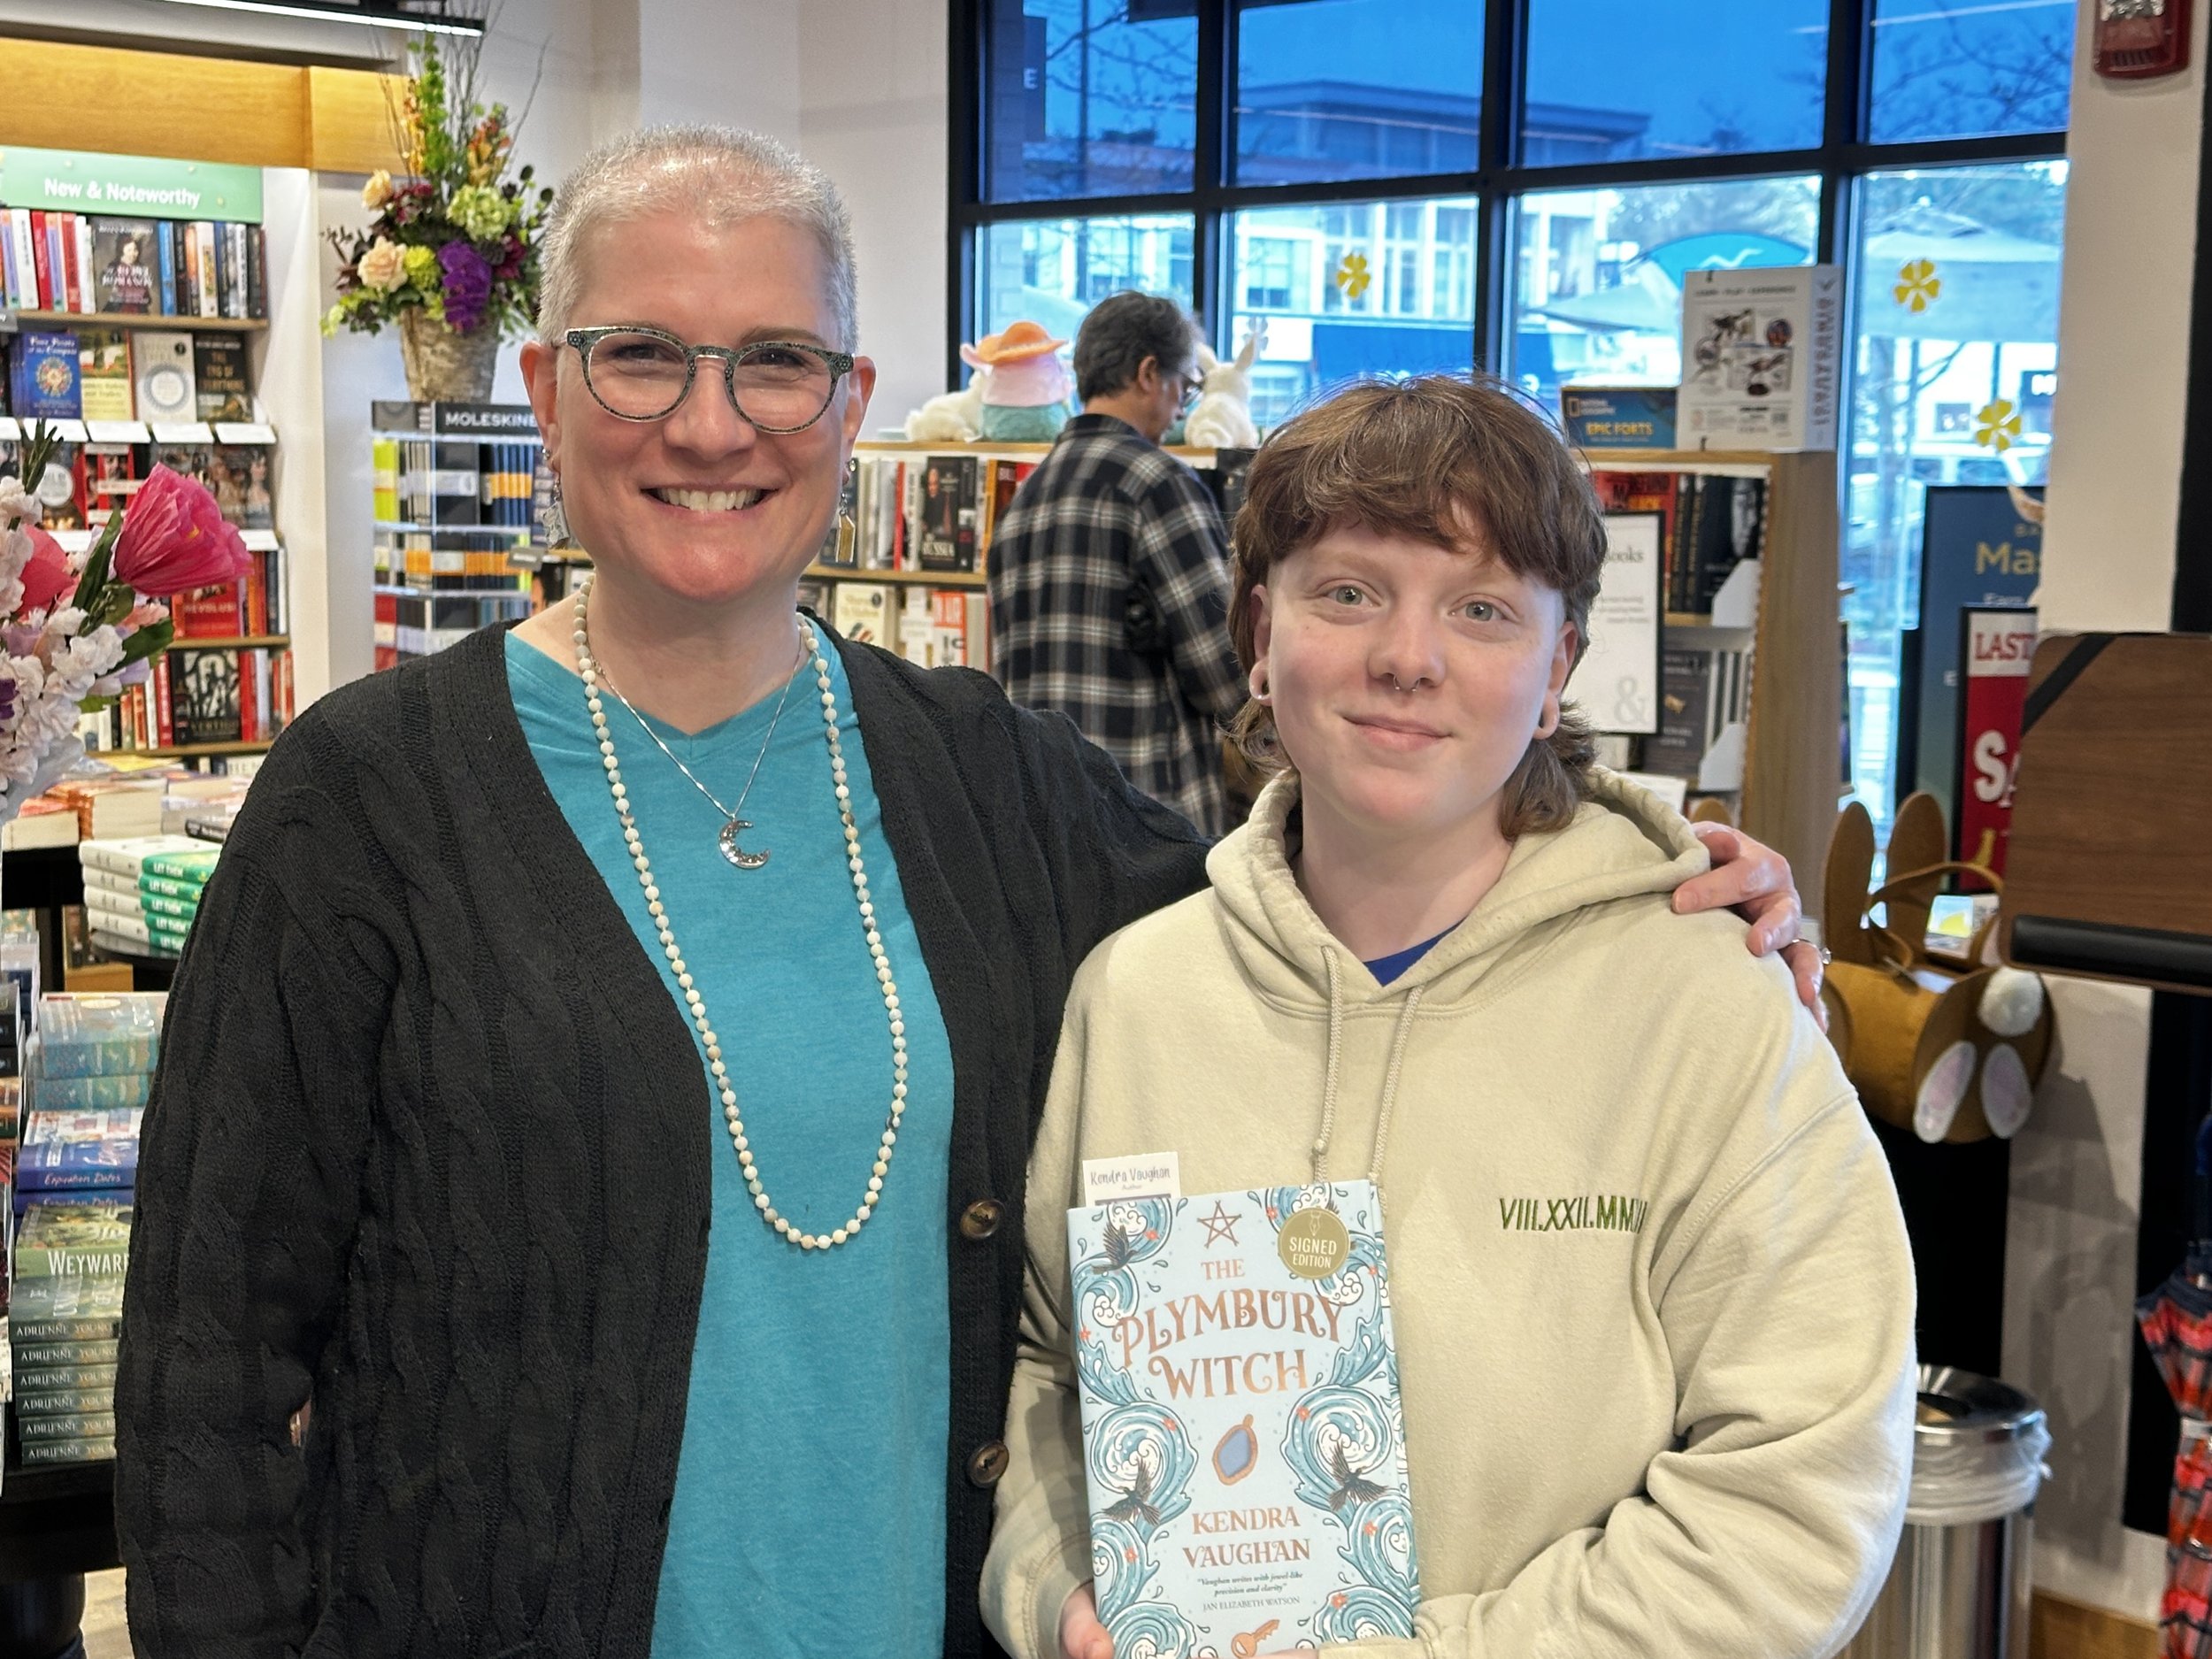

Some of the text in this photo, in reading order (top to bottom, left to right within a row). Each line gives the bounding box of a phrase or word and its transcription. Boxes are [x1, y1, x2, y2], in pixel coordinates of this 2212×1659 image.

[44, 178, 202, 211] New & Noteworthy
[1604, 546, 1644, 564] ooks
[1975, 541, 2040, 575] Ma
[44, 1171, 121, 1187] Expiration Dates
[1090, 1166, 1171, 1186] Kendra Vaughan
[1288, 1235, 1338, 1256] SIGNED
[1201, 1258, 1246, 1281] THE
[1292, 1253, 1333, 1270] EDITION
[1111, 1287, 1346, 1368] PLYMBURY
[1148, 1348, 1309, 1400] WITCH
[1191, 1505, 1301, 1535] KENDRA
[1182, 1538, 1311, 1569] VAUGHAN
[1253, 1573, 1270, 1582] with
[1270, 1571, 1303, 1582] jewel-like
[1214, 1586, 1245, 1597] precision
[1246, 1585, 1260, 1594] and
[1202, 1596, 1301, 1612] JAN ELIZABETH WATSON
